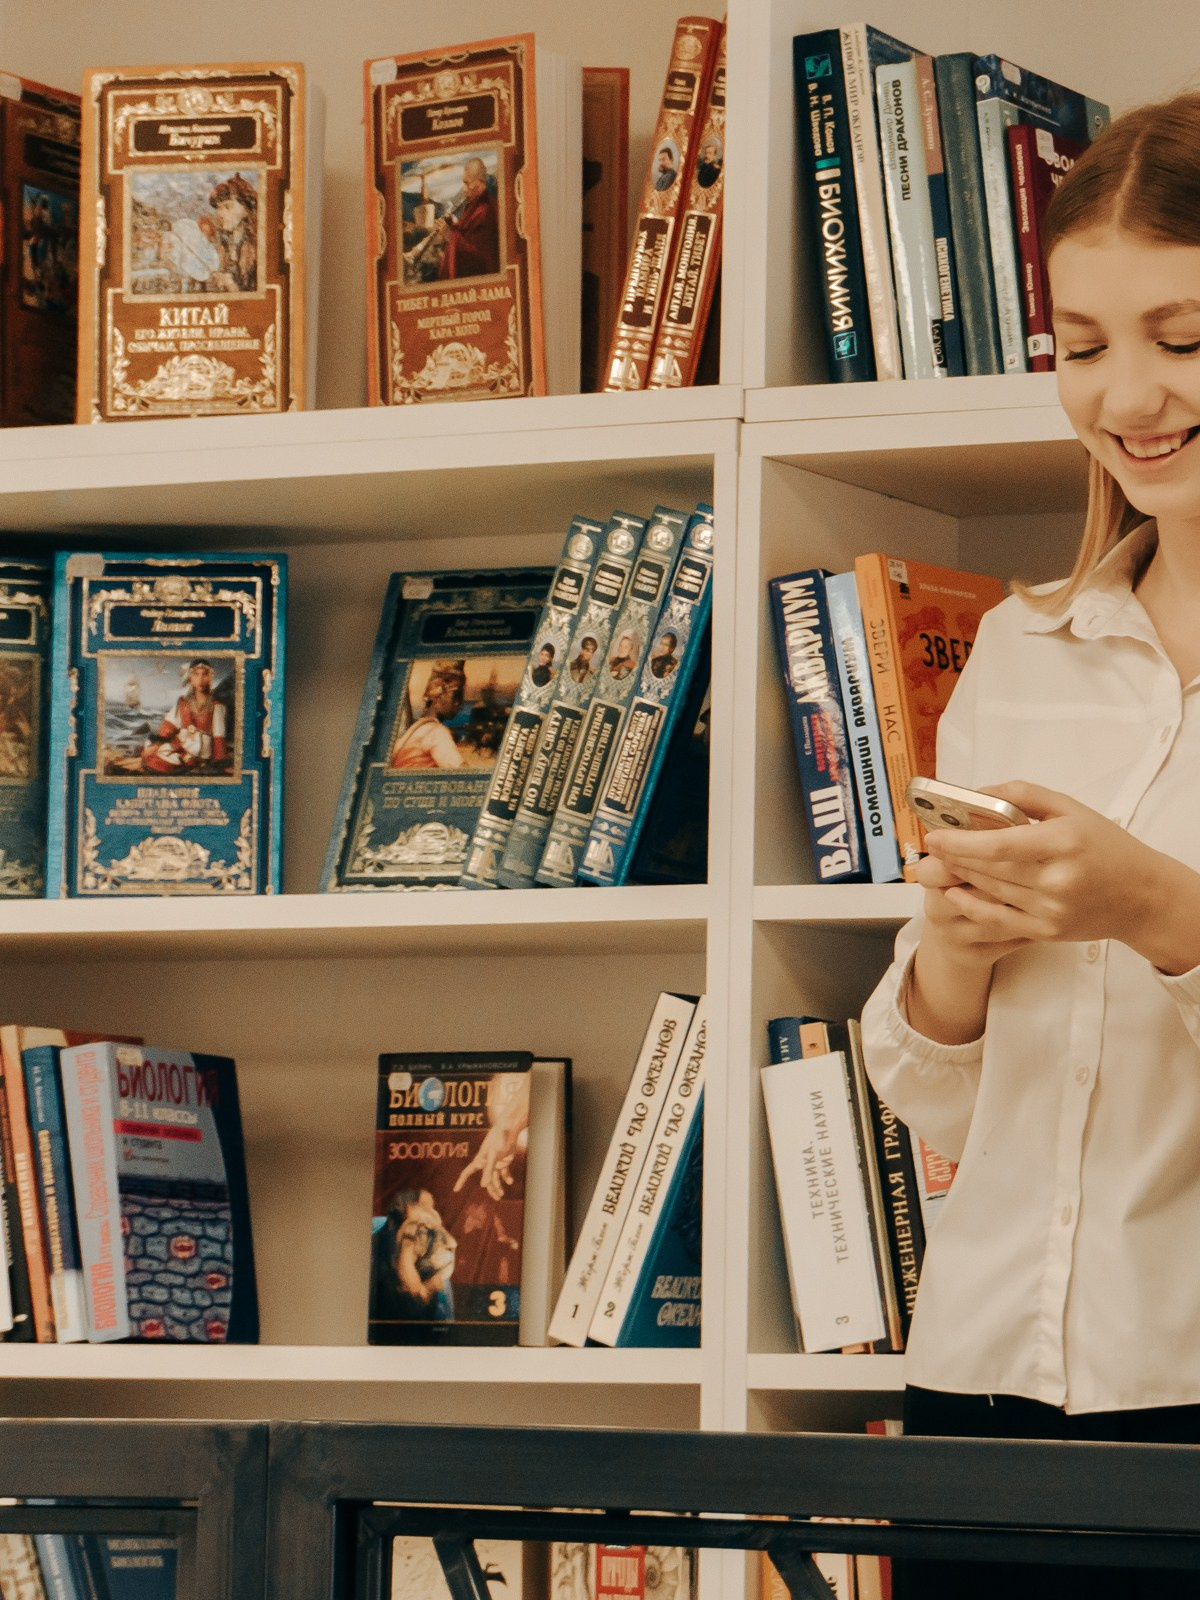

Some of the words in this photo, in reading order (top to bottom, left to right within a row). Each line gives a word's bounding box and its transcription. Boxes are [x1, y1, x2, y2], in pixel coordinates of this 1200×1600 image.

[843, 31, 856, 75] ЖИВОЙ
[847, 78, 858, 104] МИР
[891, 79, 908, 152] ДРАКОНОВ
[810, 110, 824, 156] Шведова
[825, 120, 838, 154] Комов
[852, 109, 865, 163] ОКЕАНОВ
[898, 155, 911, 200] ПЕСНИ
[1014, 143, 1025, 185] человека
[1018, 187, 1030, 233] Эволюция
[691, 233, 706, 266] ТИБЕТ
[819, 182, 856, 331] БИОХИМИЯ
[396, 297, 428, 312] ТИБЕТ
[441, 287, 513, 308] ДАЛАЙ-ЛАМА
[935, 237, 955, 321] ПСИХОГЕНЕТИКА
[159, 303, 229, 326] КИТАЙ
[429, 324, 480, 340] ХАРА-ХОТО
[462, 310, 491, 324] ГОРОД
[779, 576, 829, 704] АКВАРИУМ
[869, 618, 886, 674] ЗВЕРИ
[883, 704, 901, 742] НАС
[493, 722, 520, 800] ПУТЕШЕСТВИЕ
[501, 761, 518, 802] ВОКРУГ
[513, 726, 529, 761] СВЕТА
[525, 786, 539, 807] ПО
[532, 751, 549, 785] БЕЛУ
[543, 709, 562, 751] СВЕТУ
[568, 785, 581, 807] ТРИ
[577, 705, 604, 784] КРУГОСВЕТНЫХ
[585, 721, 611, 797] ПУТЕШЕСТВИЯ
[609, 737, 630, 799] ПУТЕШЕСТВИЕ
[615, 755, 632, 802] КАПИТАНА
[810, 785, 852, 879] ВАШ
[389, 1112, 445, 1127] ПОЛНЫЙ
[450, 1112, 484, 1126] КУРС
[810, 1090, 831, 1141] НАУКИ
[388, 1141, 469, 1160] ЗООЛОГИЯ
[569, 1303, 580, 1320] 1
[599, 1140, 639, 1216] ВЕЛИКИЙ
[629, 1101, 651, 1140] ЧАС
[640, 1016, 681, 1099] ОКЕАНОВ
[804, 1140, 825, 1220] ТЕХНИКА.
[821, 1147, 850, 1264] ТЕХНИЧЕСКИЕ
[603, 1301, 616, 1318] 2
[636, 1140, 676, 1216] ВЕЛИКИЙ
[664, 1100, 688, 1140] ЧАС
[886, 1171, 918, 1316] ИНЖЕНЕРНАЯ
[91, 1260, 118, 1330] БИОЛОГИЯ
[488, 1290, 507, 1318] 3
[836, 1315, 849, 1326] 3
